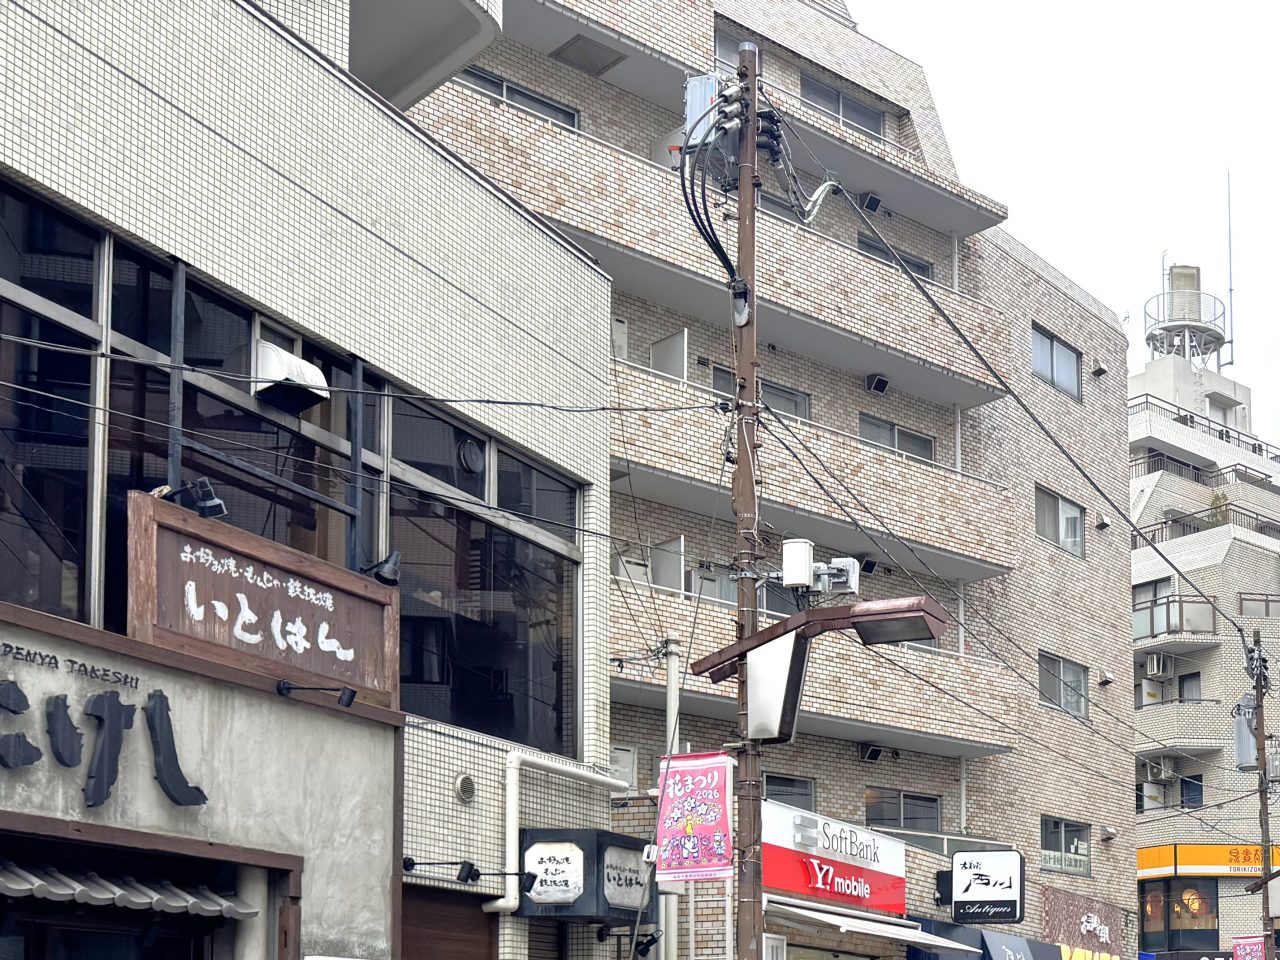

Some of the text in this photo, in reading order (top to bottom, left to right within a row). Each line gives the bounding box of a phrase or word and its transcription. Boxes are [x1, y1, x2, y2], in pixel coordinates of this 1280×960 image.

[184, 580, 355, 662] いとはん
[64, 658, 140, 689] TAKESHI
[666, 771, 719, 798] 花まつり
[696, 790, 720, 800] 2026
[822, 822, 880, 864] SoftBank
[607, 873, 643, 887] いとはん
[960, 904, 1011, 916] Antiques
